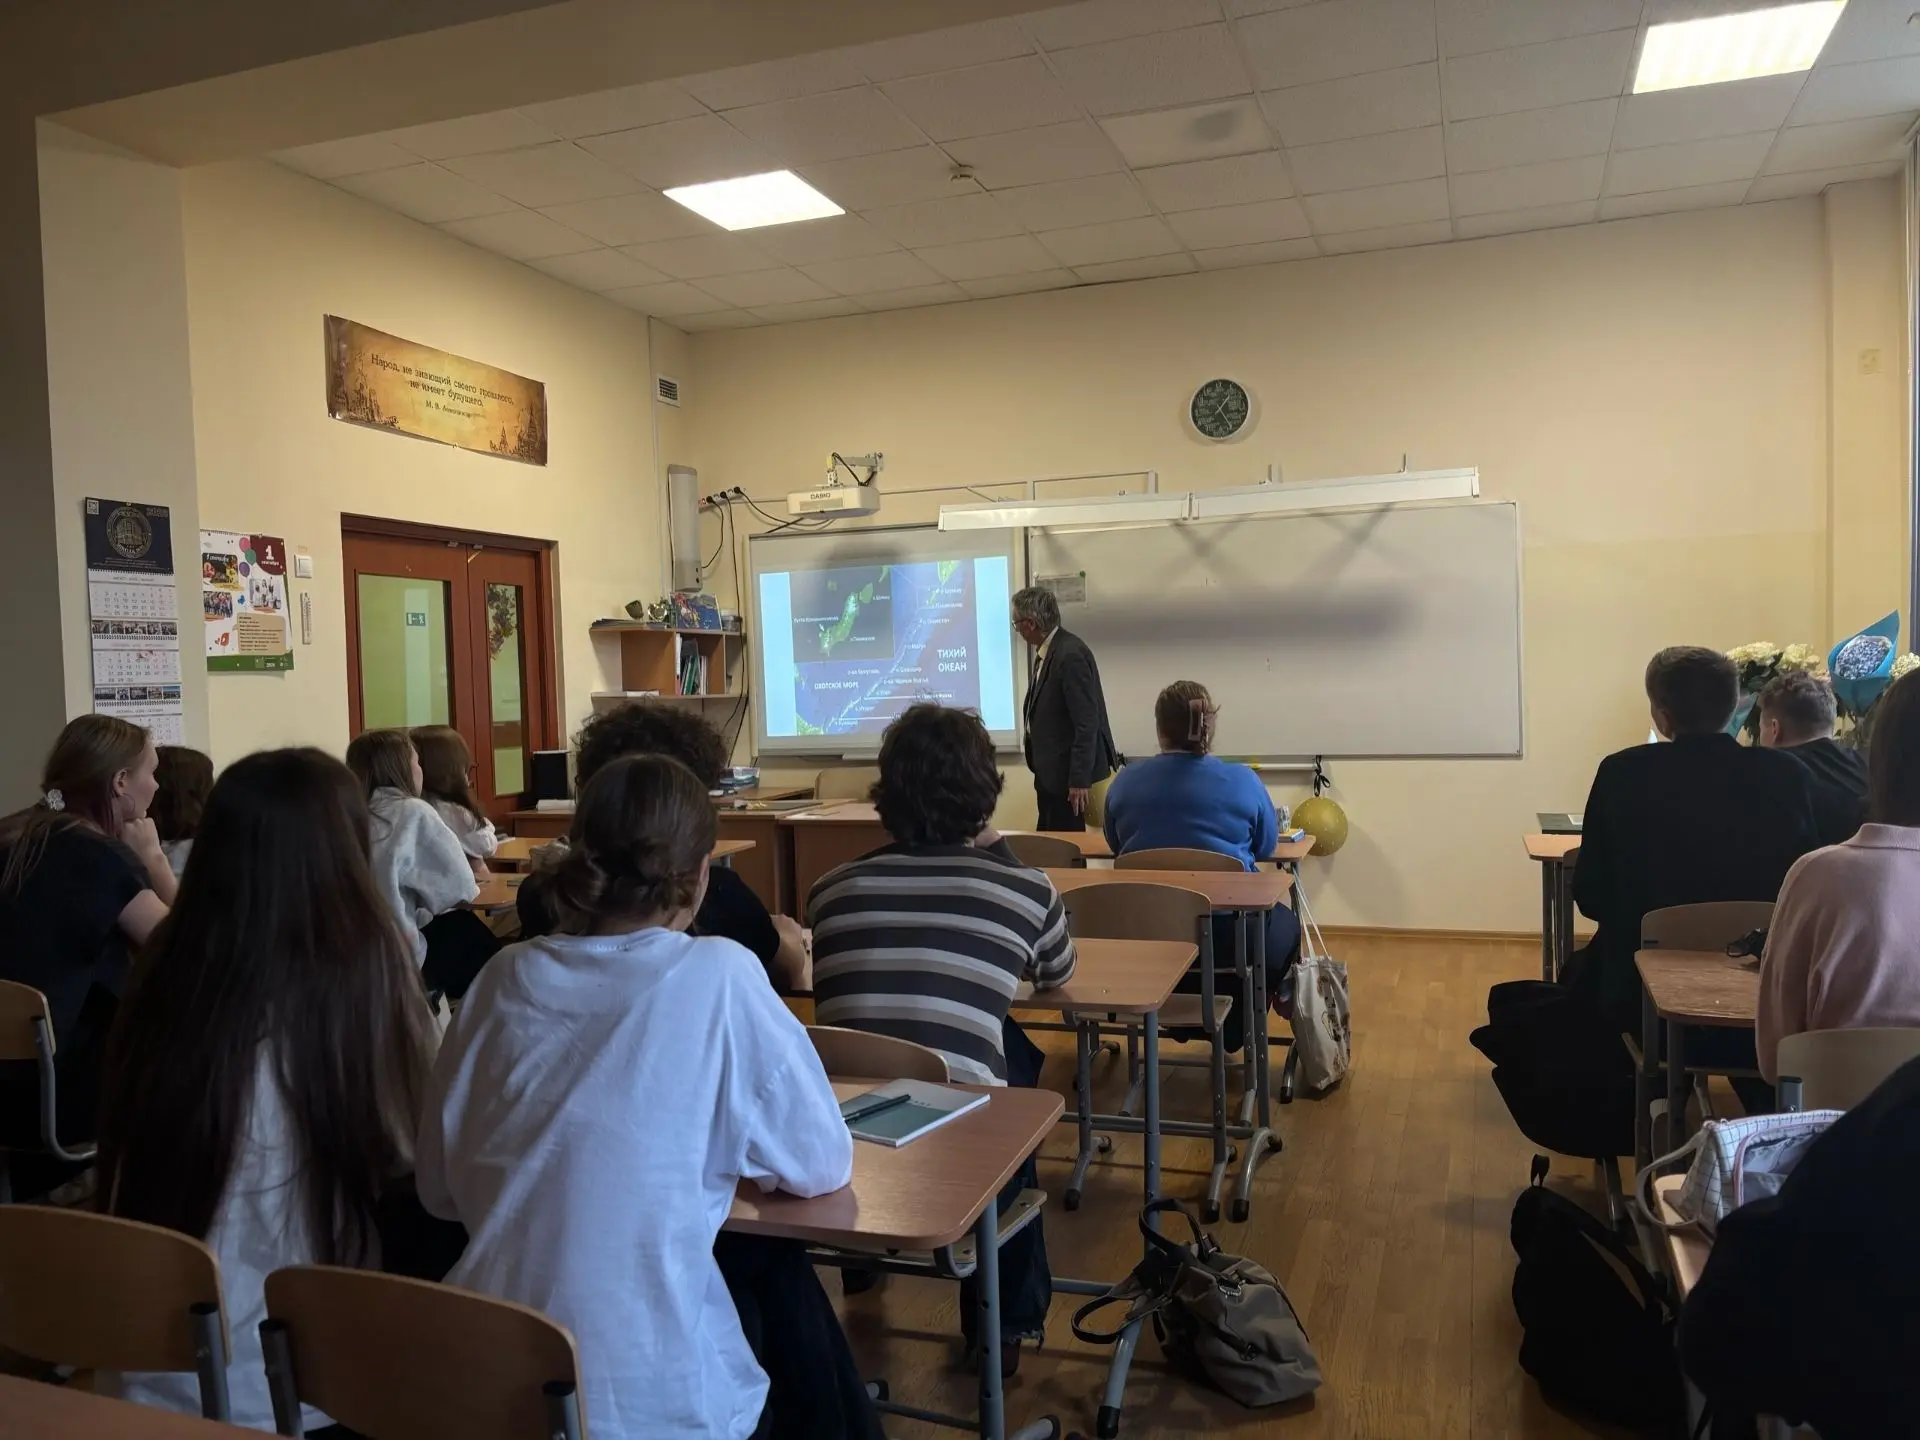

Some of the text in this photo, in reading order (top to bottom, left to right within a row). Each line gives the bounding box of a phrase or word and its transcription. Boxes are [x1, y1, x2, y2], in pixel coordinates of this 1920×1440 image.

[371, 354, 400, 372] Народ,
[402, 366, 413, 376] не
[415, 369, 451, 386] знающий
[454, 380, 477, 395] своего
[410, 380, 420, 390] не
[422, 383, 446, 397] имеет
[810, 492, 831, 500] CASIO
[265, 545, 275, 560] 1
[936, 646, 967, 659] ТИХИЙ
[937, 662, 967, 673] ОКЕАН
[843, 680, 859, 689] МОРЕ
